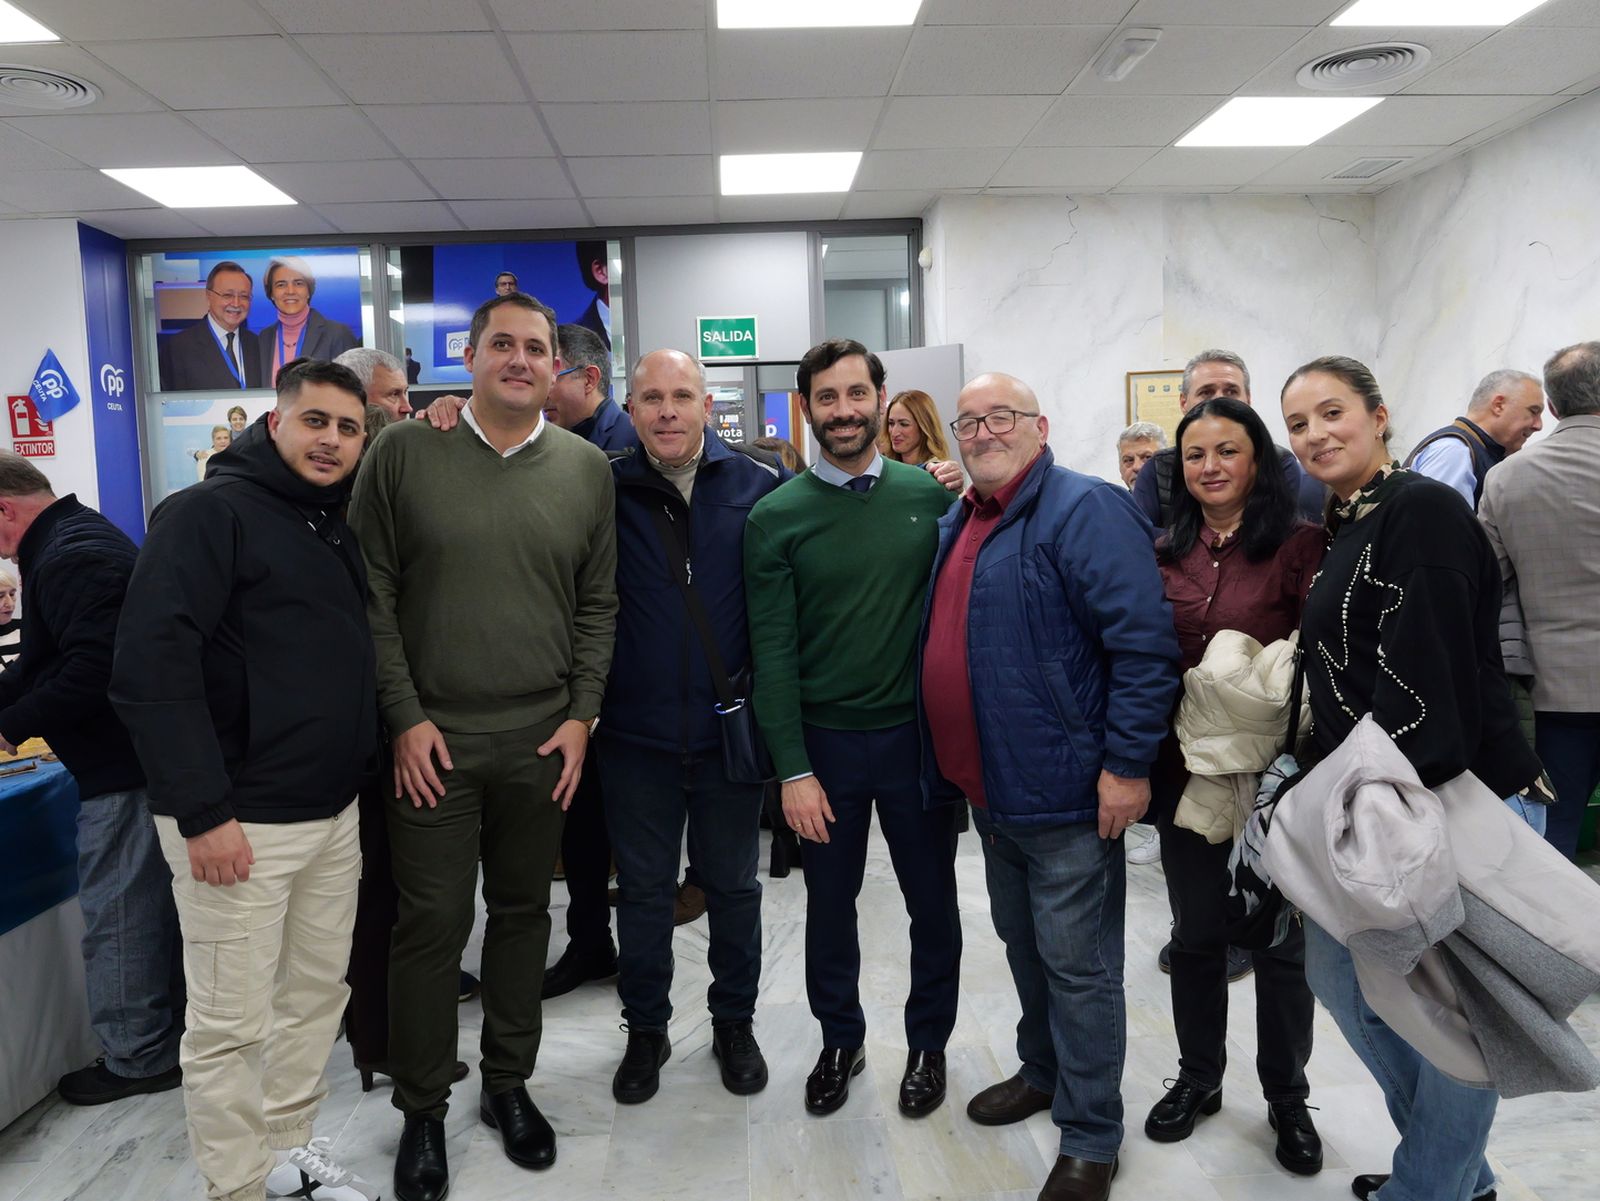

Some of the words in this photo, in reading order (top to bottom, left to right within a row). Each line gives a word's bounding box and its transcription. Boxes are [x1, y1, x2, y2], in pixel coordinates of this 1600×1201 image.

[702, 330, 753, 342] SALIDA
[32, 379, 48, 402] CEUTA
[107, 402, 123, 411] CEUTA
[716, 428, 743, 437] vota
[14, 442, 54, 455] EXTINTOR
